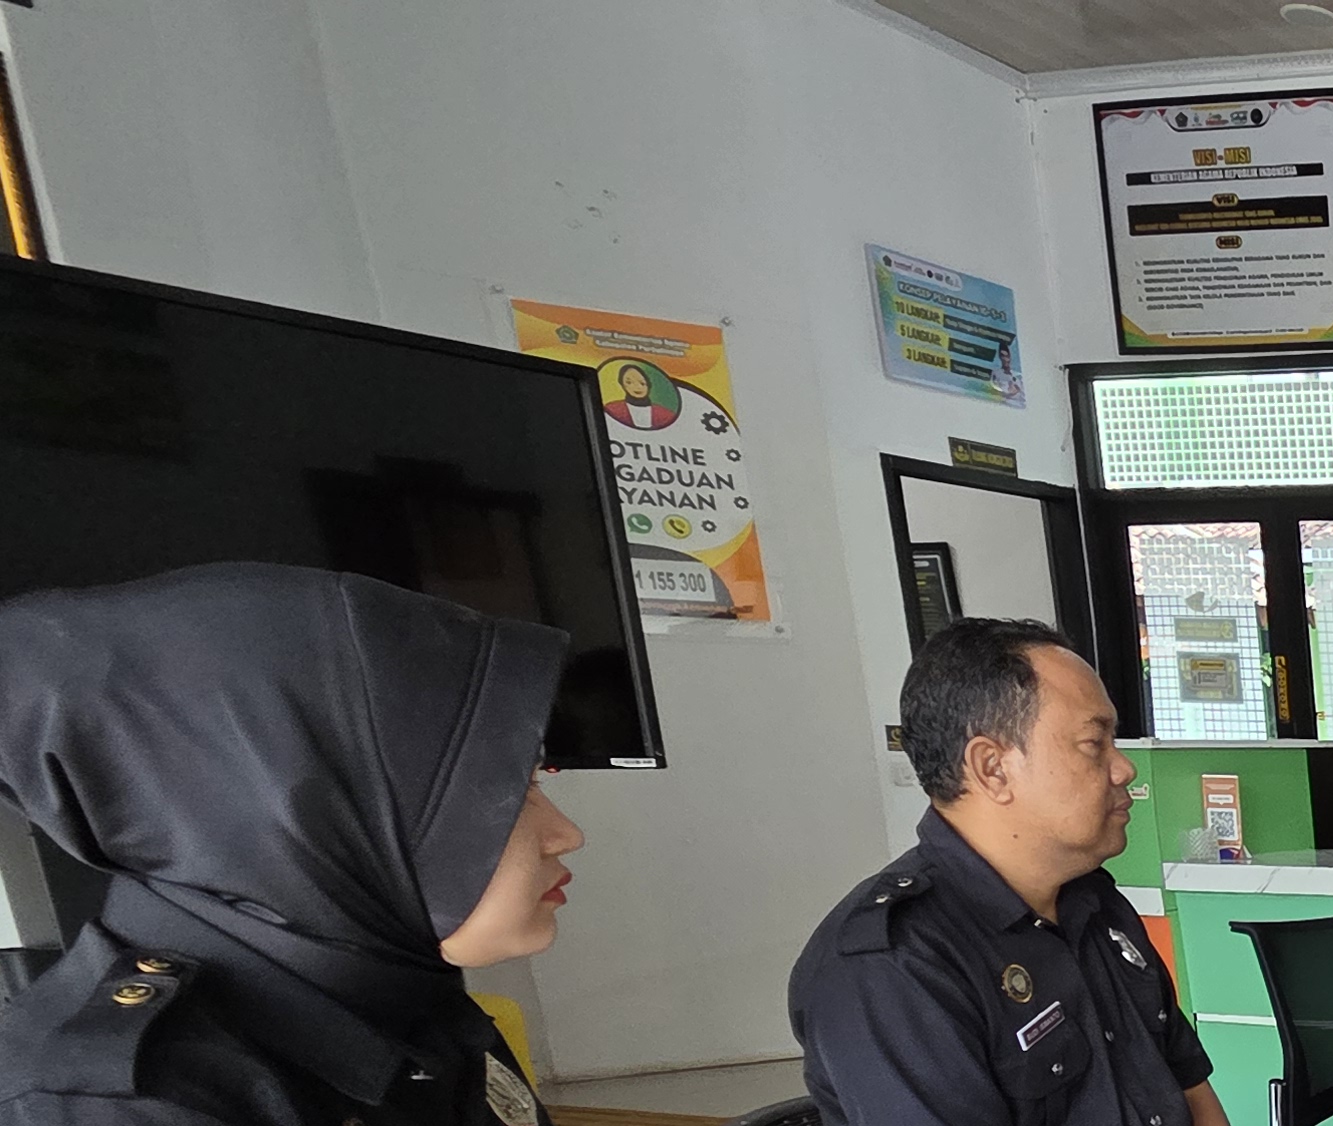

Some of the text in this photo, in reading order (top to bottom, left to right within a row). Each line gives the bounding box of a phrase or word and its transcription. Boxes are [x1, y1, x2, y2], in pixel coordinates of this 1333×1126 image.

[1194, 147, 1250, 165] VISI MISI
[615, 463, 735, 491] GADUAN
[619, 486, 717, 511] YANAN
[649, 570, 676, 591] 155
[679, 572, 707, 593] 300
